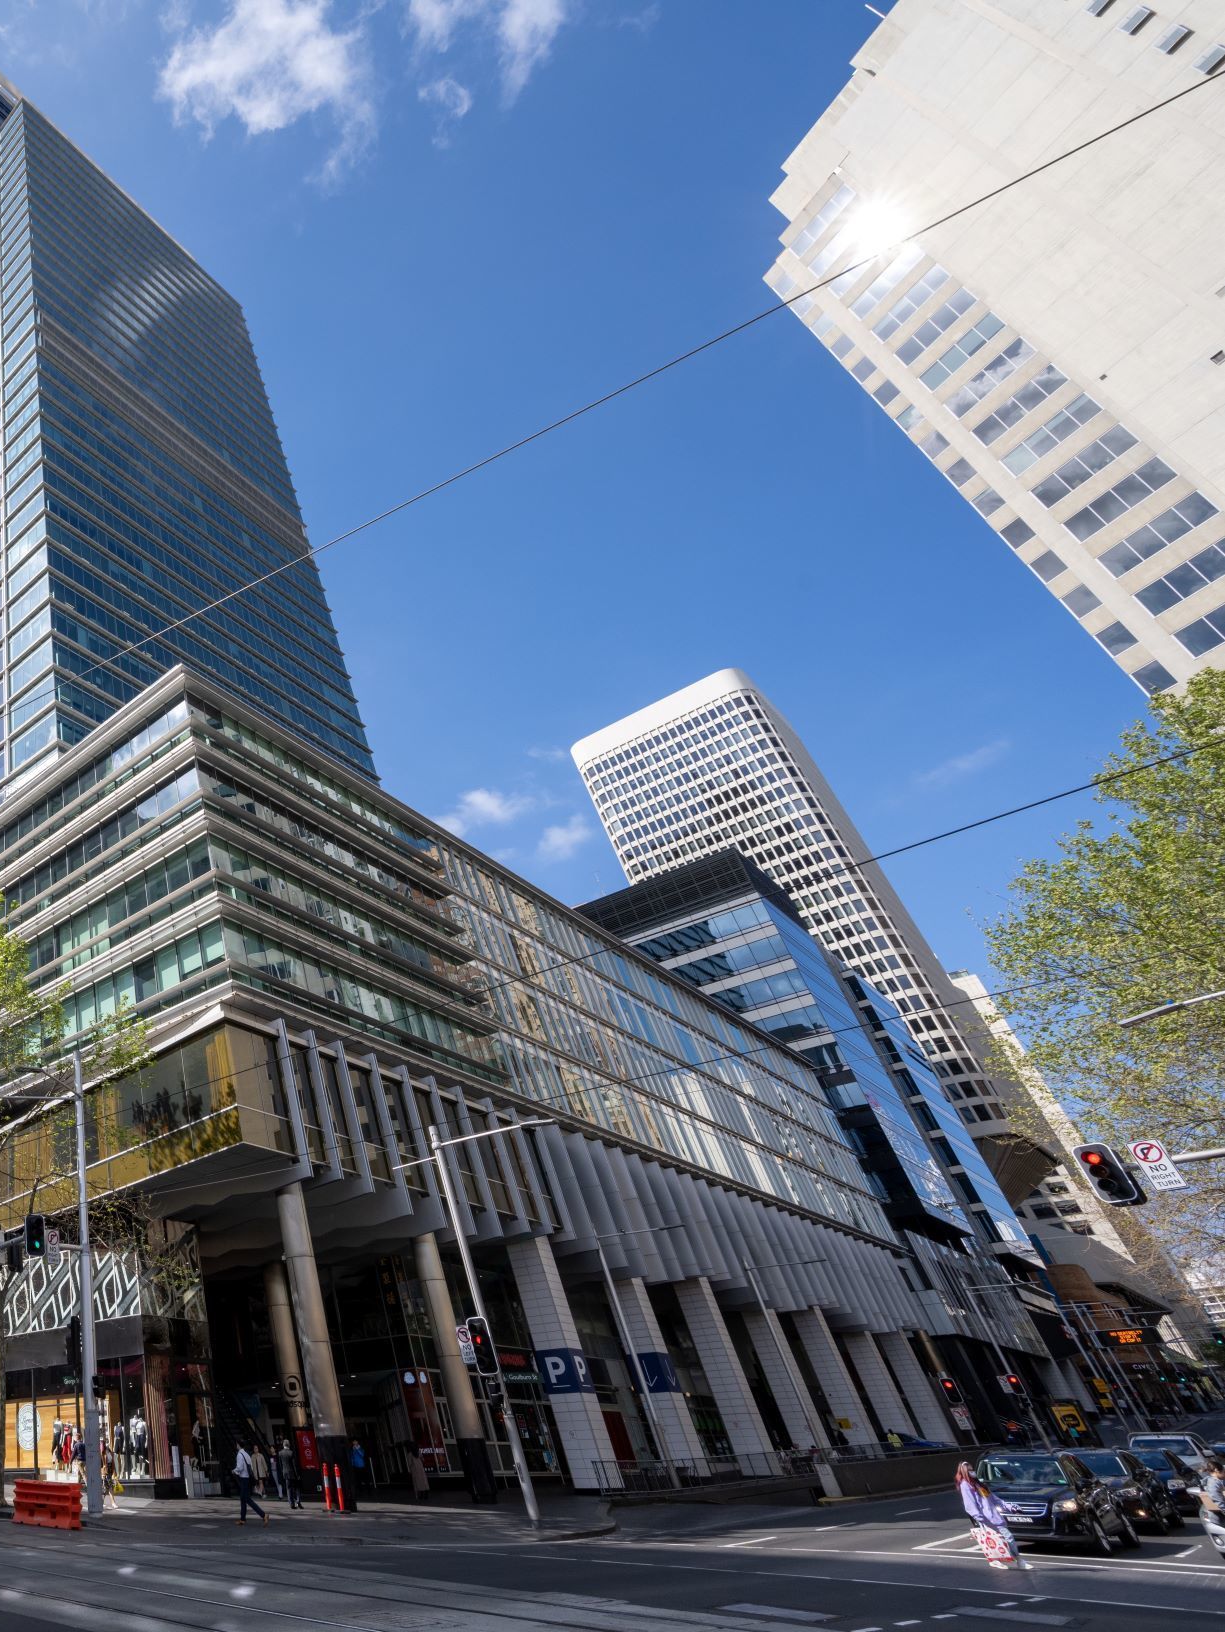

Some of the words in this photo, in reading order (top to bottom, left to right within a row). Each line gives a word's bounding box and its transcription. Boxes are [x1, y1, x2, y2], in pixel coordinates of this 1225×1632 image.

[1148, 1163, 1168, 1173] NO
[1151, 1172, 1176, 1181] RIGHT
[1157, 1179, 1182, 1187] TURN
[544, 1356, 566, 1384] P
[573, 1355, 586, 1383] P
